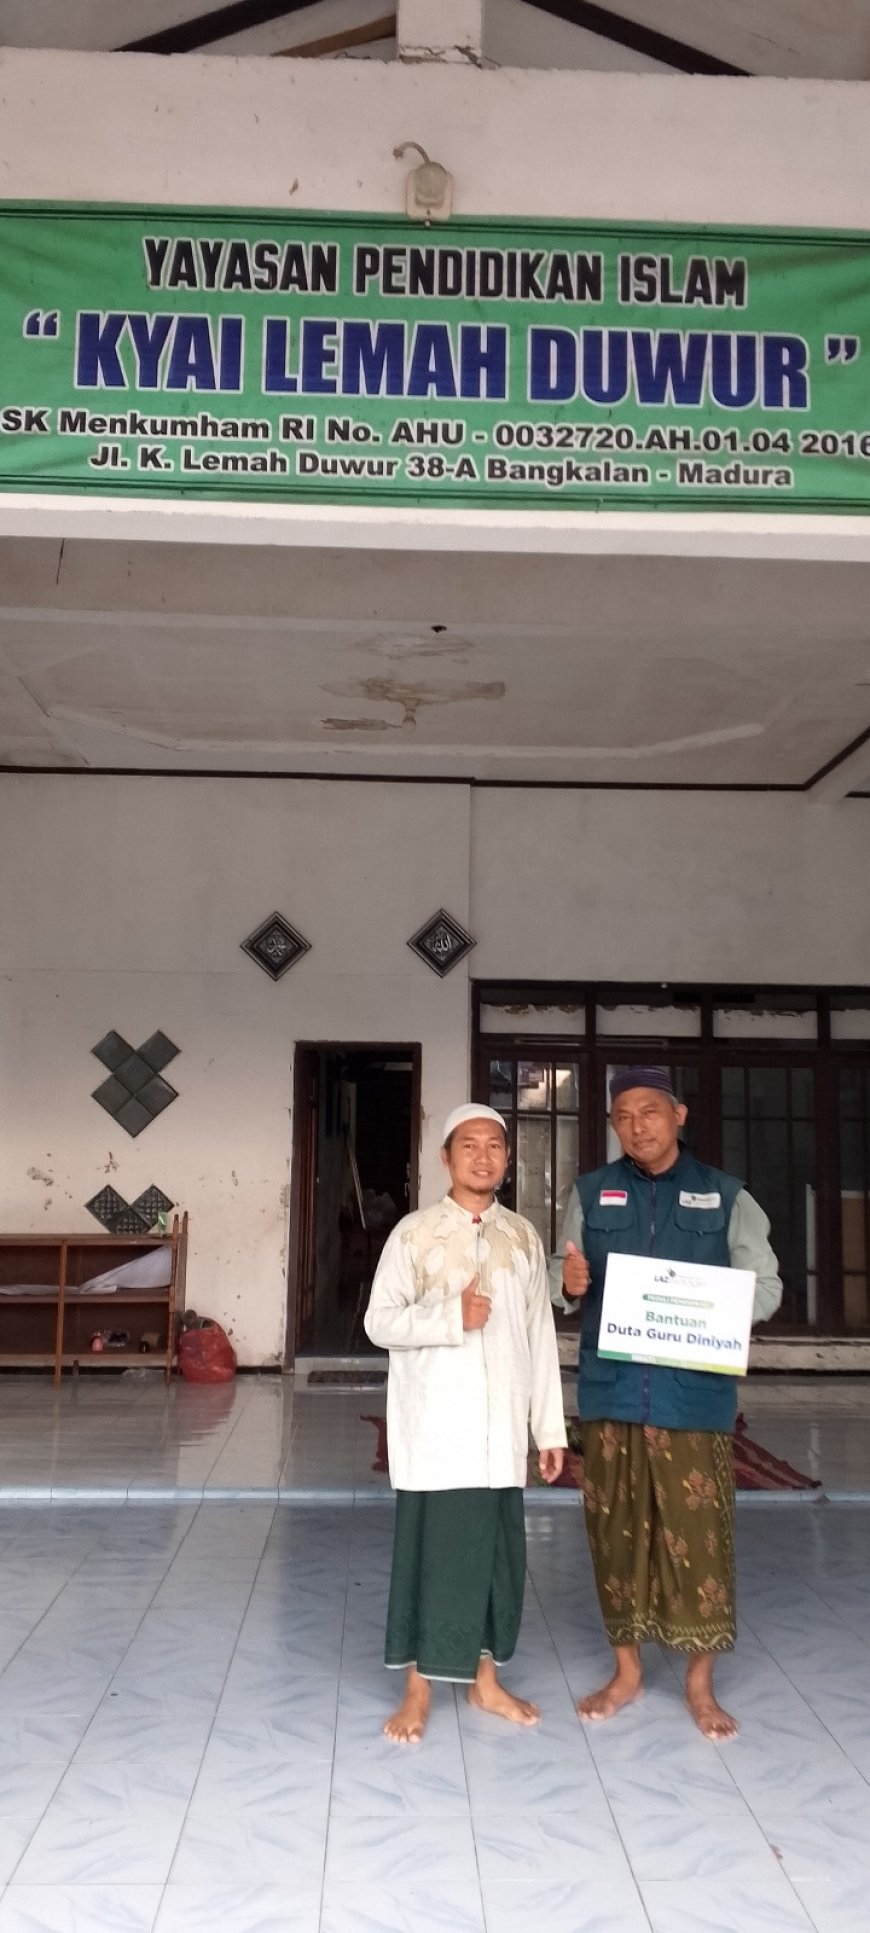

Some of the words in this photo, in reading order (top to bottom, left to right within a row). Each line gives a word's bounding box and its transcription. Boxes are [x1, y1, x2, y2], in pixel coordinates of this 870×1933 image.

[144, 238, 338, 293] YAYASAN
[354, 245, 602, 304] PENDIDIKAN
[620, 255, 746, 307] ISLAM
[76, 312, 244, 392] KYAI
[264, 317, 508, 401] LEMAH
[529, 325, 811, 411] DUWUR
[1, 410, 47, 434] SK
[59, 411, 269, 440] Menkumham
[282, 417, 315, 442] RI
[327, 419, 381, 443] No.
[392, 420, 464, 446] AHU
[495, 423, 791, 454] 0032720.AH.01.04
[802, 433, 870, 456] 2016
[90, 445, 127, 468] Jl.
[140, 448, 171, 470] K.
[184, 450, 287, 473] Lemah
[299, 454, 398, 476] Duwur
[408, 457, 477, 479] 38-A
[488, 458, 649, 487] Bangkalan
[679, 463, 792, 486] Madura
[607, 1323, 641, 1337] Duta
[647, 1329, 682, 1343] Guru
[687, 1334, 742, 1351] Diniyah
[645, 1311, 707, 1329] Bantuan
